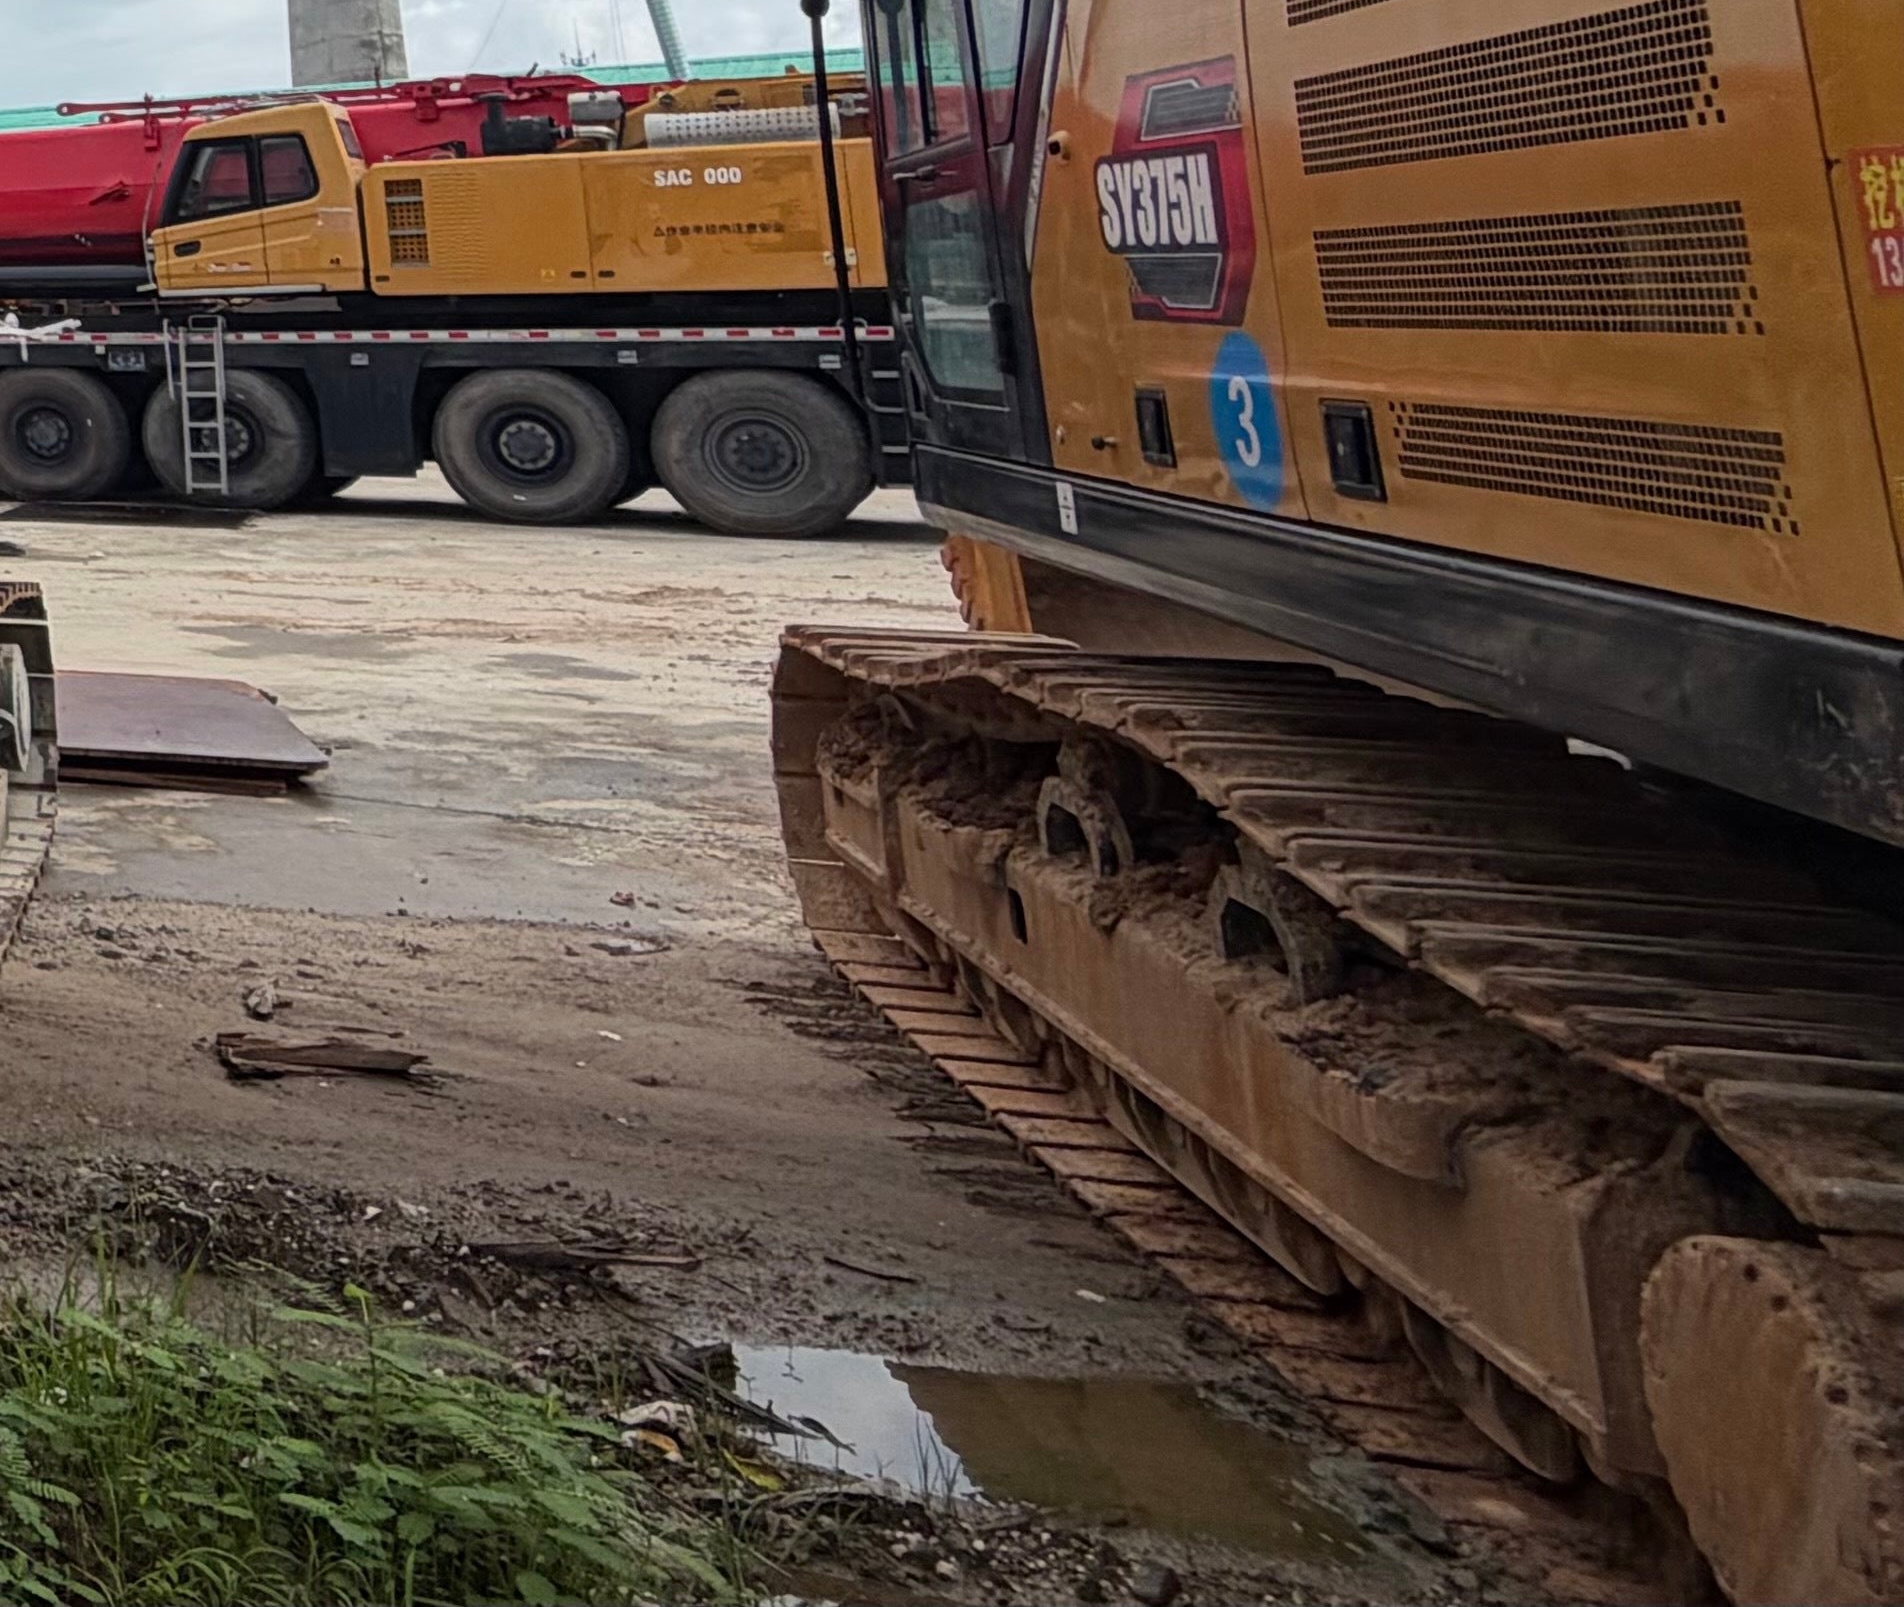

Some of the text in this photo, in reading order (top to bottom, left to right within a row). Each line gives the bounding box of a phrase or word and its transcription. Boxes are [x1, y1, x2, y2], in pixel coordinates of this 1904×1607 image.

[654, 168, 692, 187] SAC
[1097, 153, 1218, 247] SY375H
[1229, 376, 1260, 467] 3
